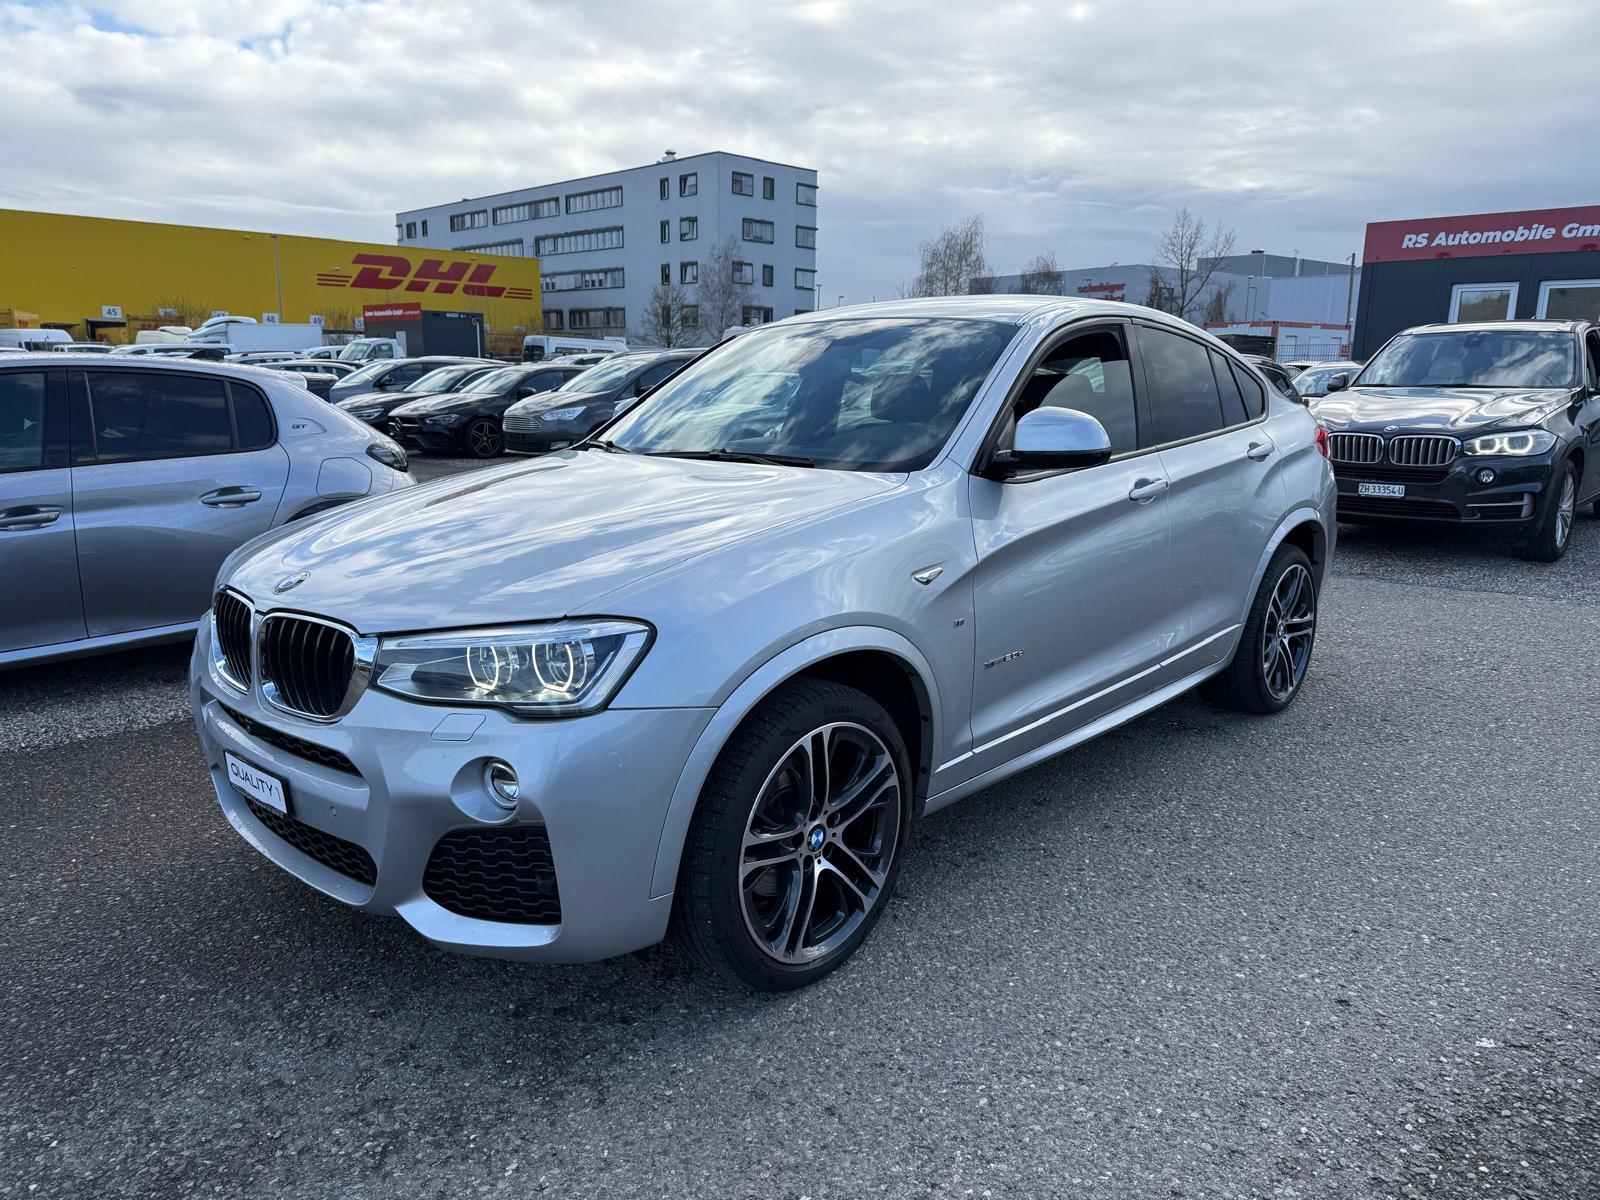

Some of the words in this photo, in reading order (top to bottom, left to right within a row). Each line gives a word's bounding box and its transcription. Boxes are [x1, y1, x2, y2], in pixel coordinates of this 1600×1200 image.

[1401, 233, 1429, 248] RS
[1430, 223, 1556, 247] Automobile
[350, 253, 506, 298] DHL
[107, 308, 117, 316] 45
[266, 315, 275, 323] 48
[313, 317, 321, 325] 49
[1360, 484, 1370, 494] ZH
[1371, 485, 1396, 495] 33354
[231, 762, 273, 797] QUALITY
